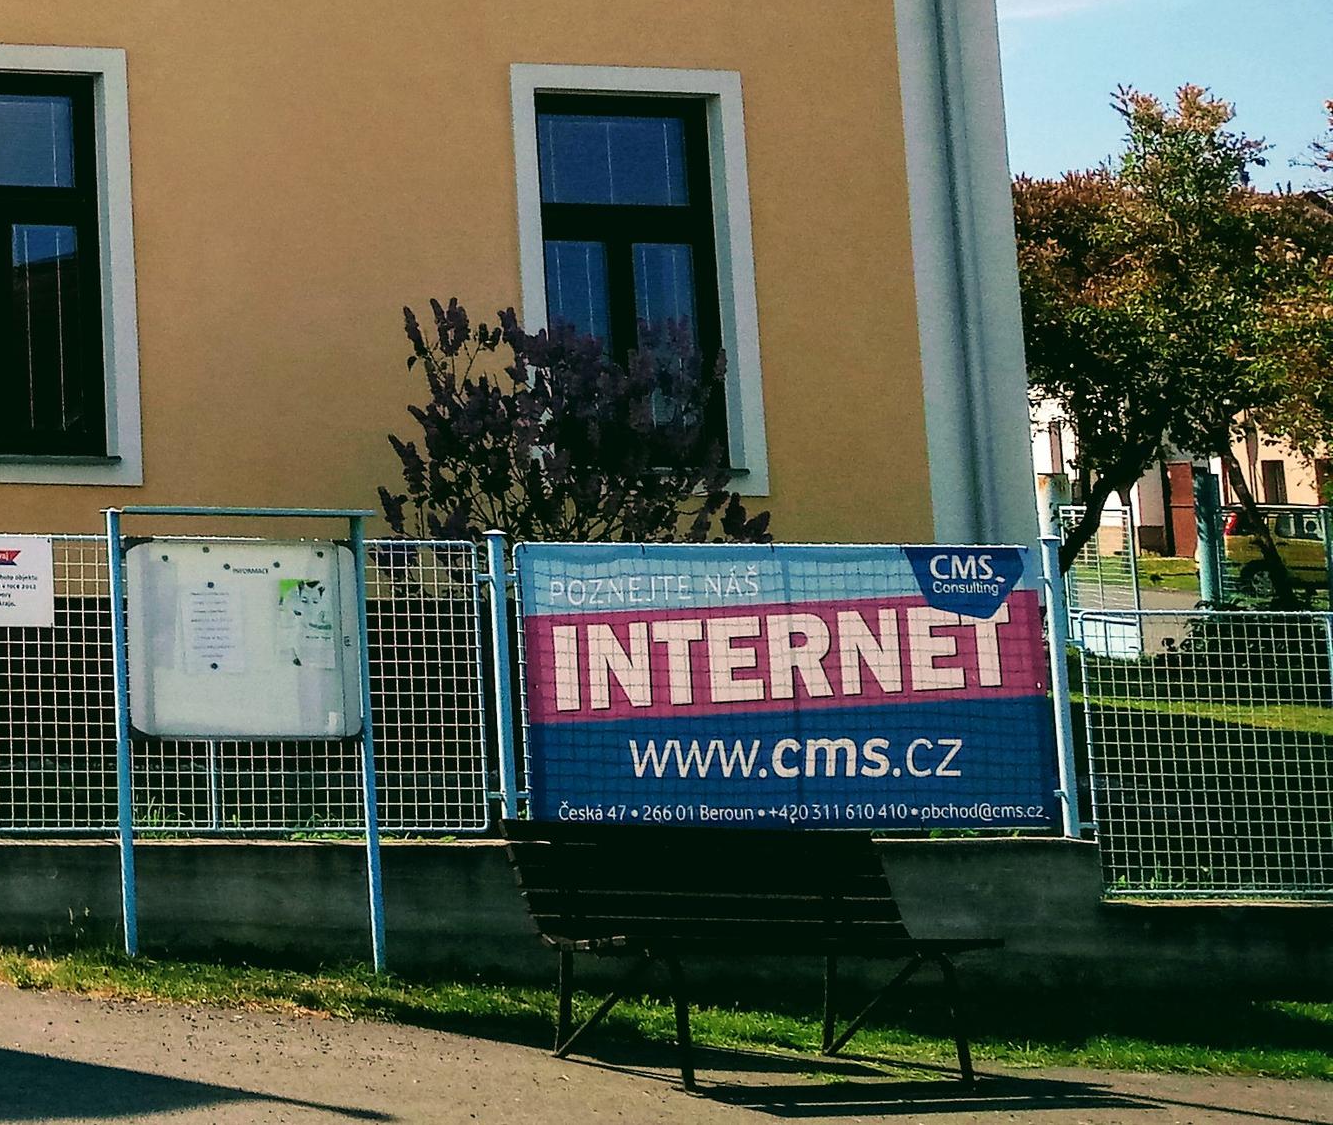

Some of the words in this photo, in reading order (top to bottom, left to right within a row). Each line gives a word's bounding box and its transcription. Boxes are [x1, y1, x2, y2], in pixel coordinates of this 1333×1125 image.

[929, 554, 993, 580] CMS
[549, 574, 693, 606] POZNEJTE
[704, 565, 759, 598] NÁŠ
[932, 581, 999, 597] Consulting
[552, 602, 1010, 713] INTERNET
[629, 737, 962, 779] www.cms.cz
[558, 801, 603, 821] Česká
[606, 804, 627, 821] 47
[642, 804, 673, 821] 266
[676, 804, 694, 821] 01
[699, 804, 754, 821] Beroun
[921, 802, 1044, 822] obchod@cms.cz
